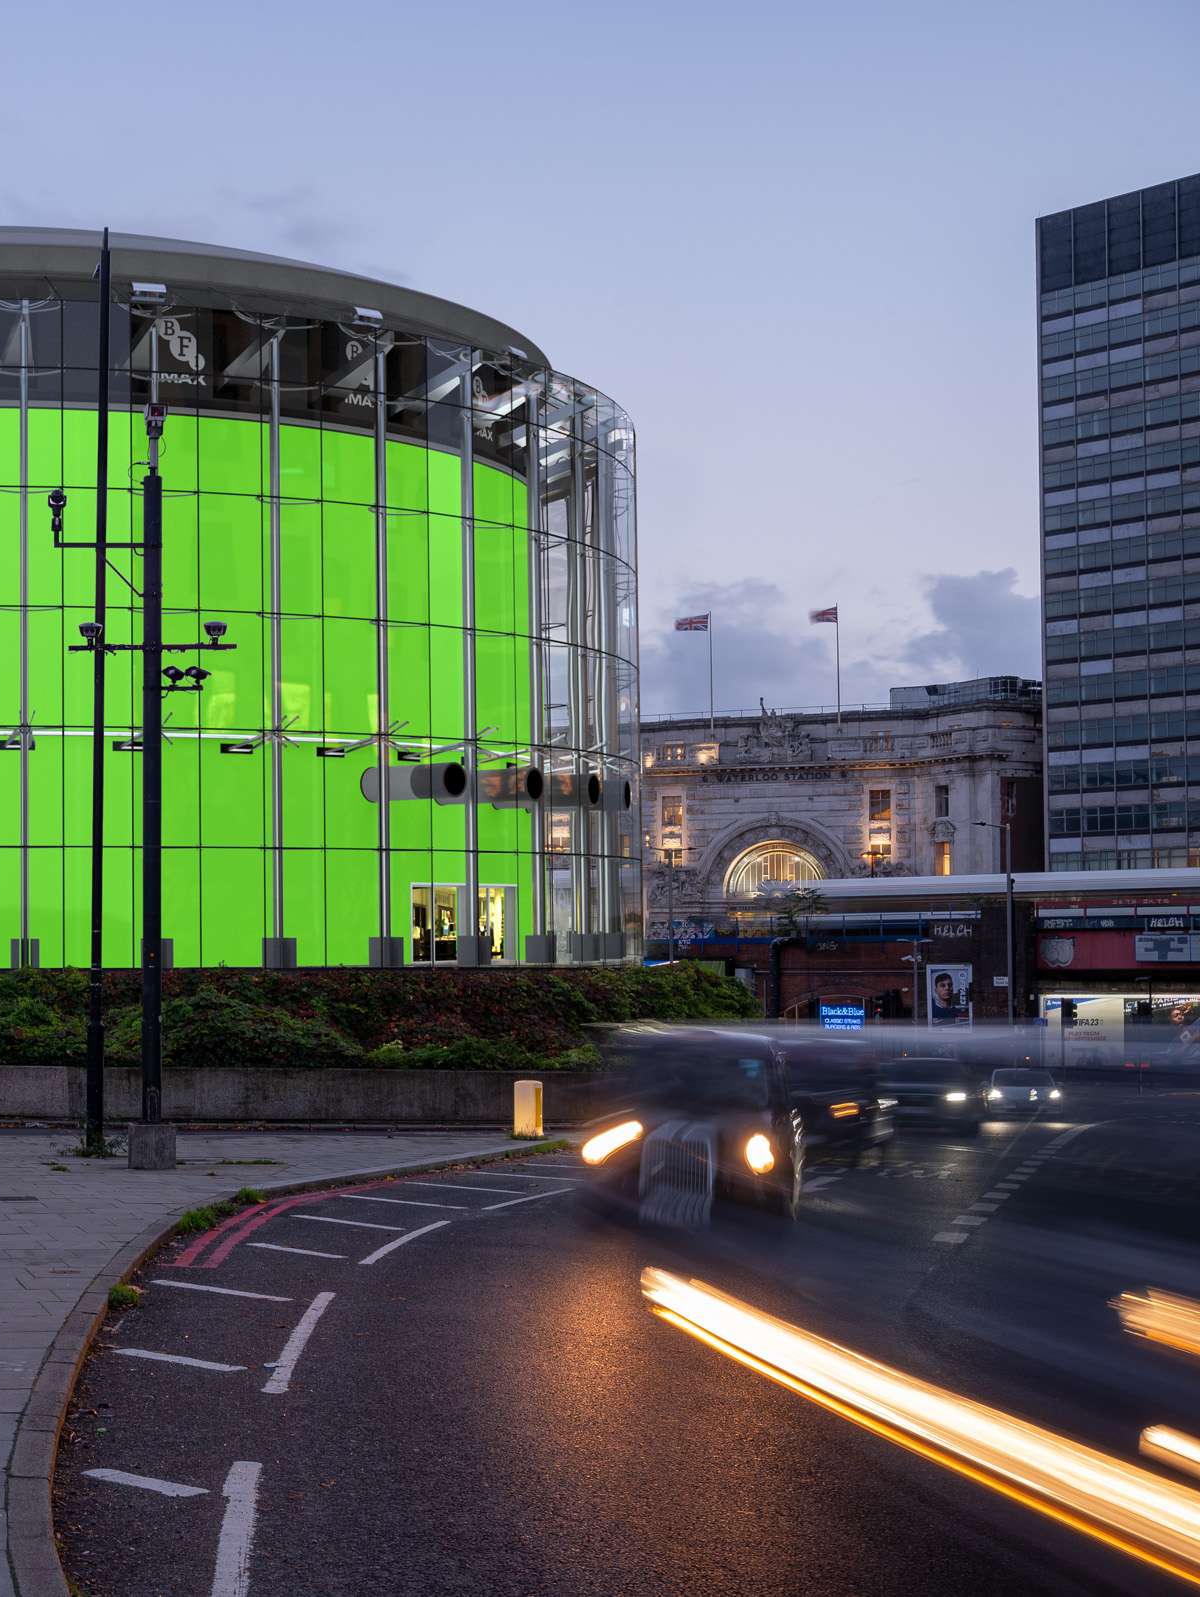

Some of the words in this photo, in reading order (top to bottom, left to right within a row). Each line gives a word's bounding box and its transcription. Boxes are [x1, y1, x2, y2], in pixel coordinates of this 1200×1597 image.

[715, 773, 779, 783] WATERLOO
[784, 771, 831, 781] STATION
[821, 1006, 865, 1016] Black&Blue
[1075, 1018, 1090, 1026] FIFA
[1090, 1018, 1099, 1026] 23
